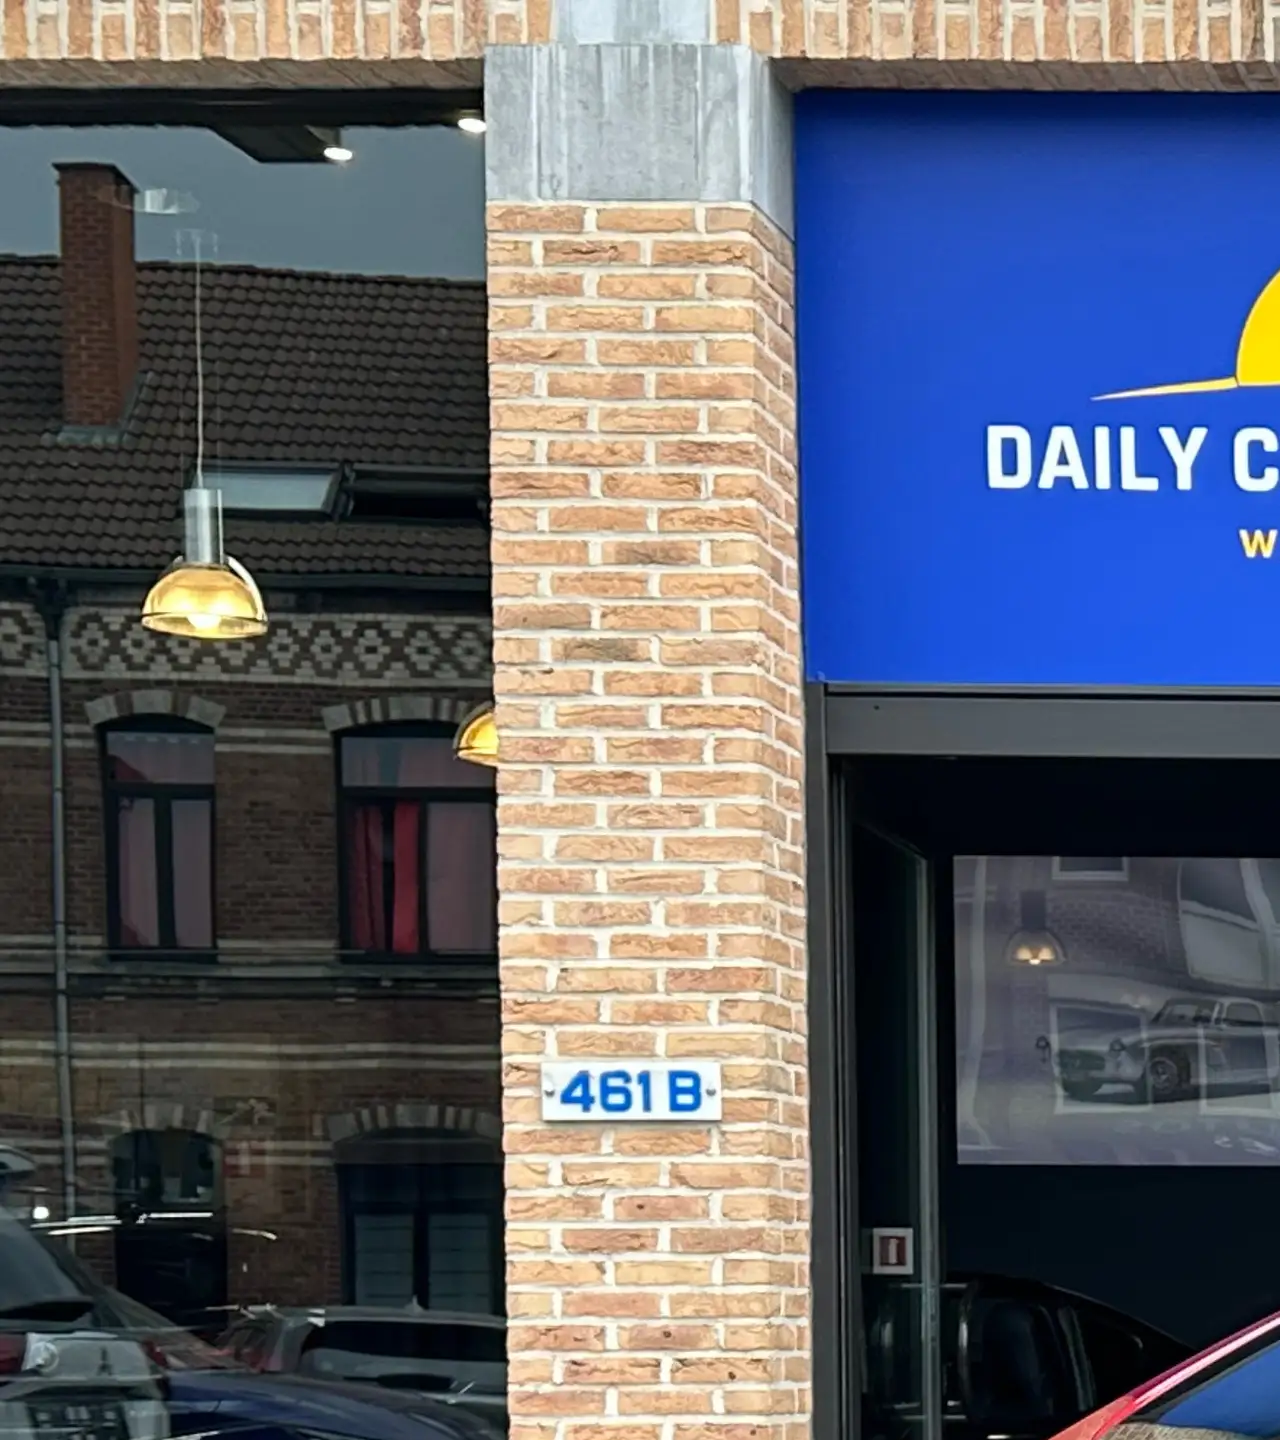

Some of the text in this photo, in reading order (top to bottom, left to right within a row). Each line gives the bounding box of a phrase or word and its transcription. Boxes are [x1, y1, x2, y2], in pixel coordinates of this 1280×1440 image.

[985, 423, 1208, 491] DAILY
[560, 1069, 702, 1113] 461 B
